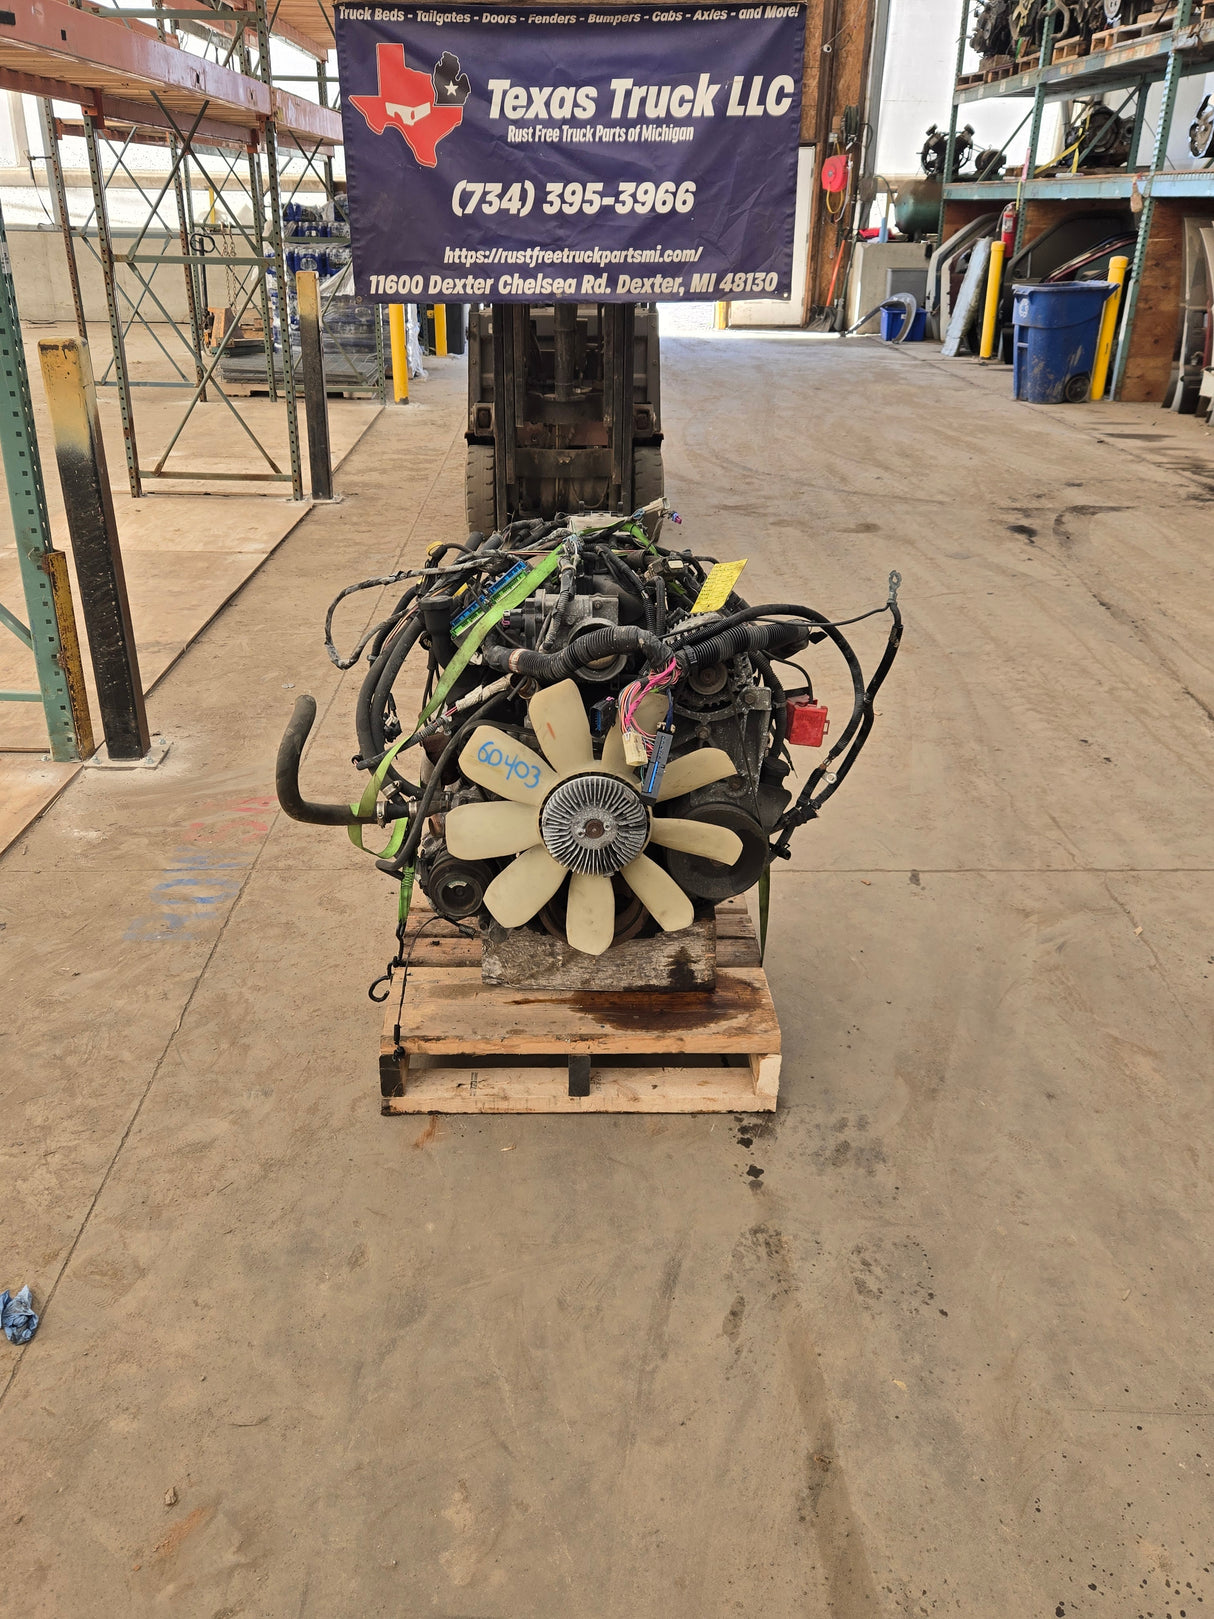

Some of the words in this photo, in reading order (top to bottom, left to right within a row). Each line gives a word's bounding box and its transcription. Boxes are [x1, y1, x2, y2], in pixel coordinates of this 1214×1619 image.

[339, 5, 372, 21] Truck
[373, 8, 405, 22] Beds
[416, 10, 471, 26] Tailgates
[481, 12, 517, 24] Doors
[528, 13, 577, 24] Fenders
[587, 13, 642, 26] Bumpers
[652, 10, 683, 22] Cabs
[692, 9, 728, 21] Axles
[738, 5, 763, 20] and
[764, 5, 800, 19] More!
[488, 79, 597, 119] Texas
[610, 73, 721, 119] Truck
[726, 75, 794, 116] LLC
[508, 125, 533, 142] Rust
[535, 125, 559, 142] Free
[562, 125, 594, 142] Truck
[595, 125, 626, 142] Parts
[628, 125, 642, 142] of
[641, 124, 694, 143] Michigan
[452, 180, 535, 217] (734)
[543, 181, 696, 214] 395-3966
[444, 245, 703, 267] https://rustfreetruckpartsmi.com/
[370, 275, 423, 294] 11600
[428, 275, 494, 294] Dexter
[498, 273, 577, 294] Chelsea
[581, 273, 611, 294] Rd.
[616, 274, 685, 296] Dexter,
[690, 273, 717, 292] MI
[719, 272, 778, 292] 48130
[477, 741, 541, 789] 60403
